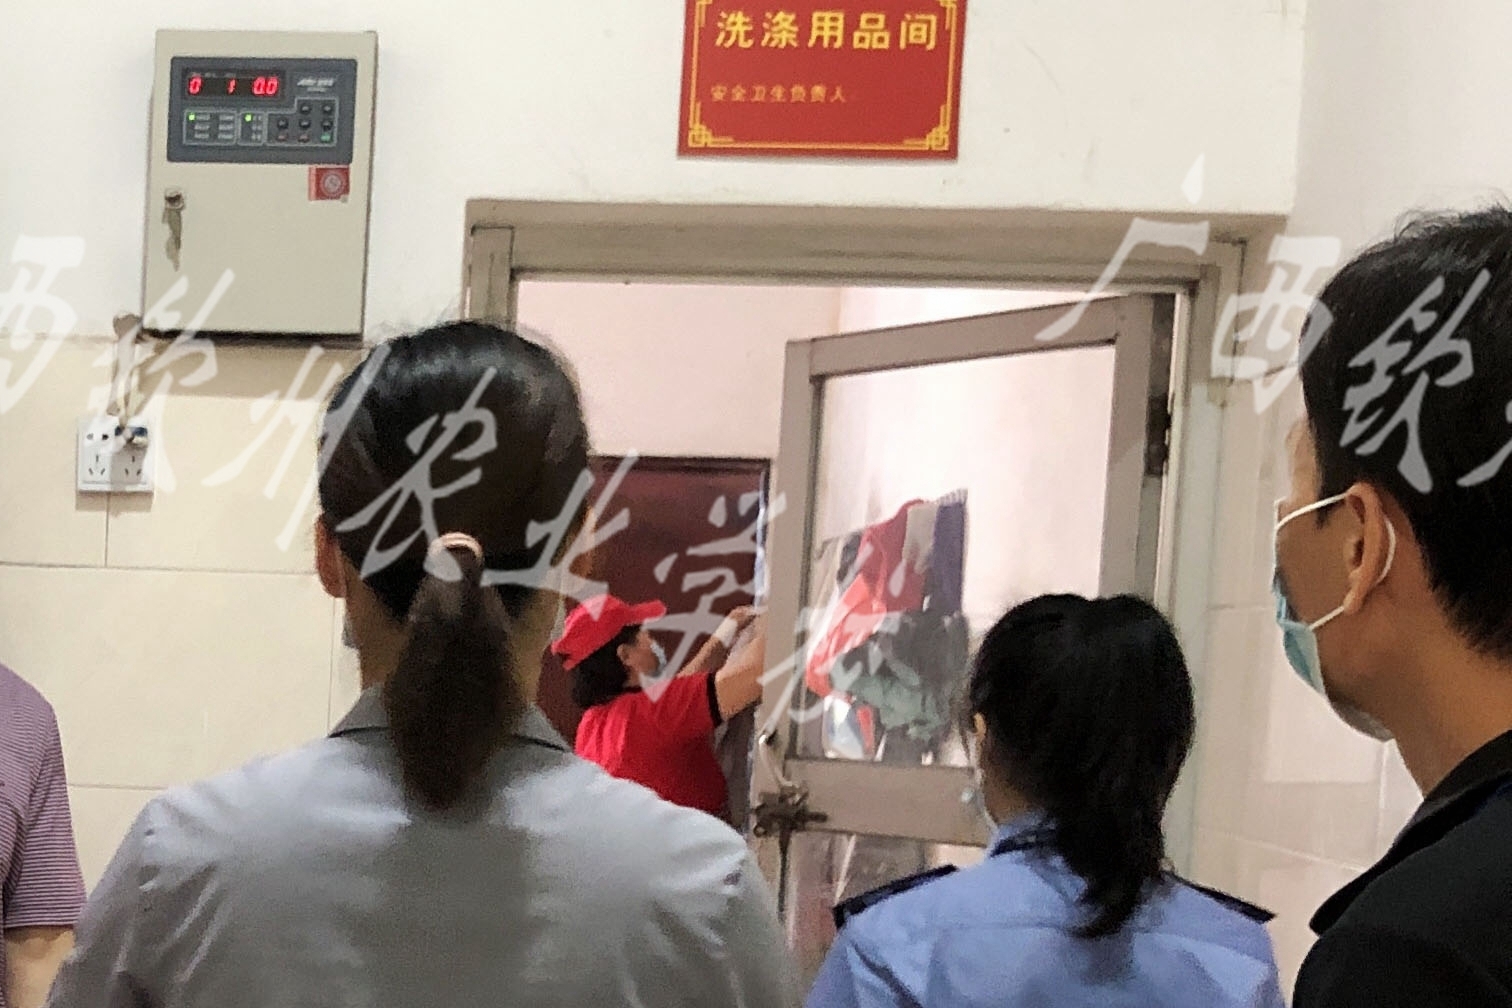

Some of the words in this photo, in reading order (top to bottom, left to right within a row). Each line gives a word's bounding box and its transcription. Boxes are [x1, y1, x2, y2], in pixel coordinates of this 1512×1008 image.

[714, 10, 938, 50] 洗涤用品间
[188, 76, 203, 95] 0
